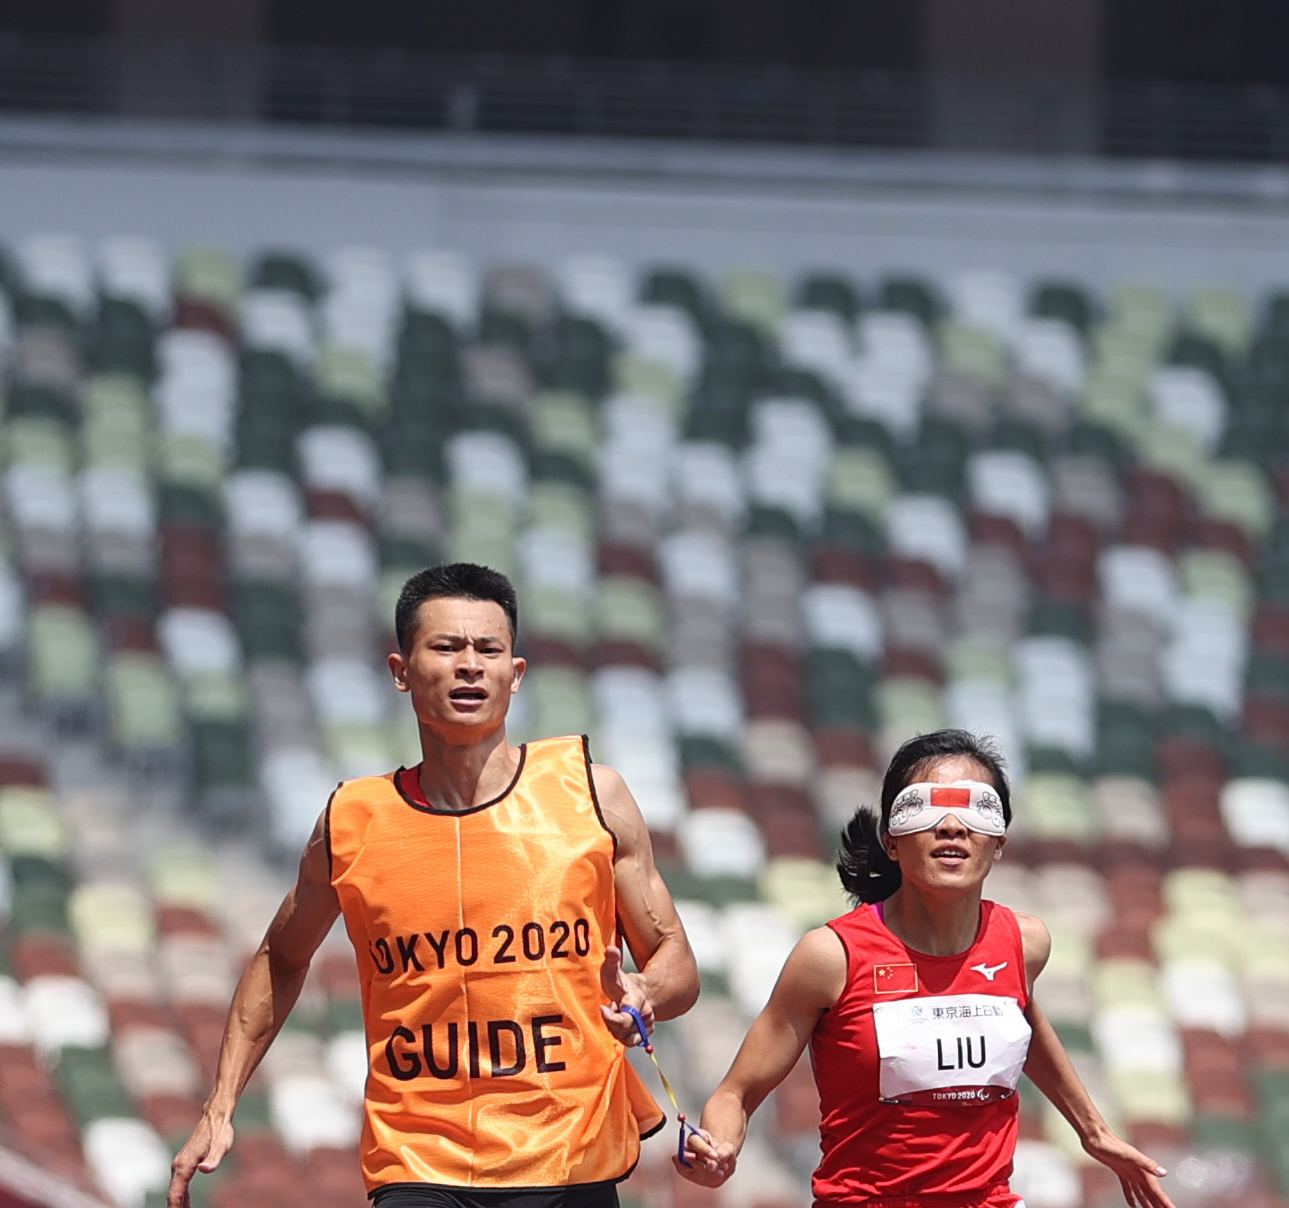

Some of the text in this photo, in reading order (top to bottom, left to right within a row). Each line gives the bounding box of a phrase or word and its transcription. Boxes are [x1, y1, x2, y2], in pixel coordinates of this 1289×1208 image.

[369, 918, 590, 975] OKYO 2020
[385, 1015, 566, 1081] GUIDE
[936, 1035, 986, 1071] LIU
[932, 1089, 976, 1101] TOKYO 2020
